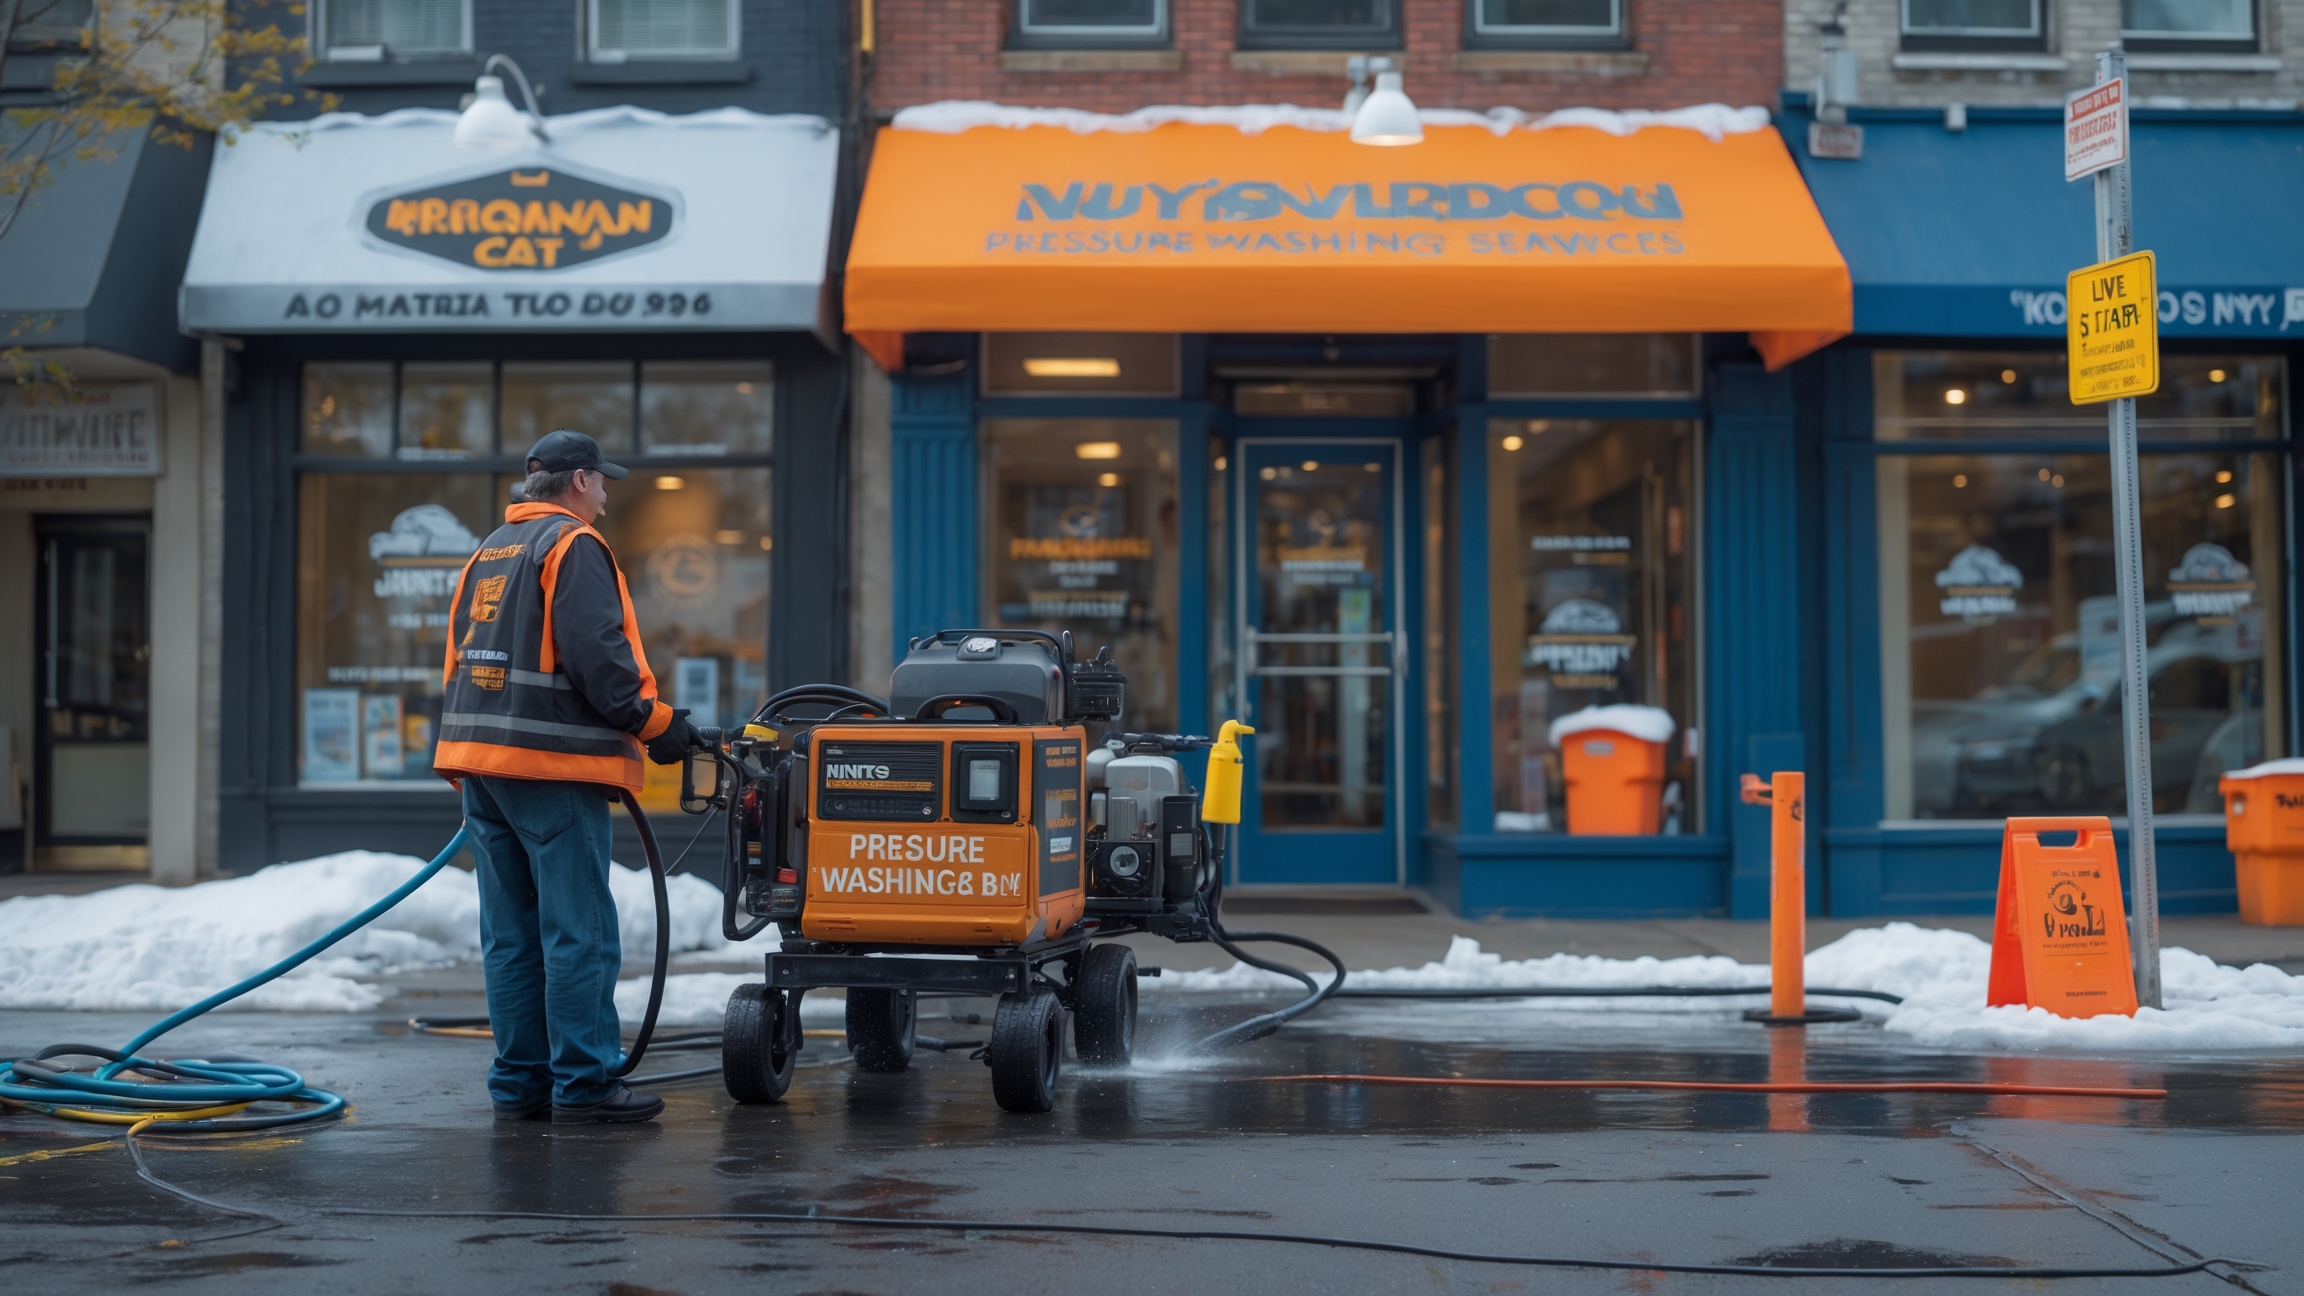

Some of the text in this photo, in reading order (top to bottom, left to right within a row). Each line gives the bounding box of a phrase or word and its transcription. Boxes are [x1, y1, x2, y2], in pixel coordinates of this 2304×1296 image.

[472, 236, 565, 268] CAT
[985, 231, 1193, 254] PRESSURE
[1206, 231, 1446, 257] WASHING
[2092, 274, 2127, 302] LIVE
[850, 834, 985, 863] PRESURE
